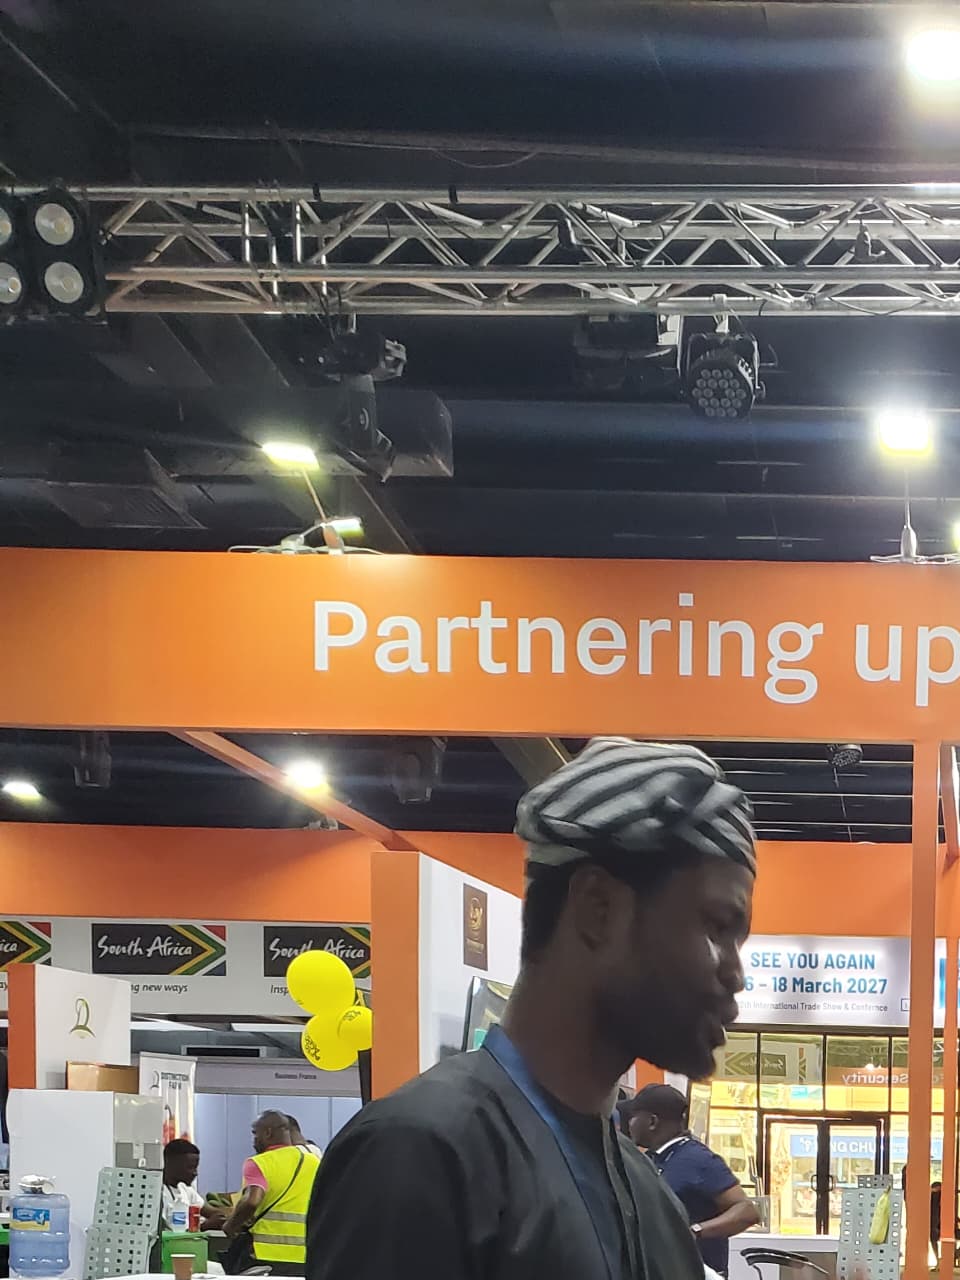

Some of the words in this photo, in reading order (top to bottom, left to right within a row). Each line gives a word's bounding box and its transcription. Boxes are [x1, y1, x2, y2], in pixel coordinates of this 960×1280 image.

[314, 592, 823, 704] Partnering
[97, 935, 144, 958] South
[146, 936, 193, 957] Africa
[751, 952, 782, 968] SEE
[786, 953, 819, 970] YOU
[823, 953, 876, 970] AGAIN
[142, 984, 162, 992] new
[164, 984, 188, 993] ways
[743, 975, 755, 992] 6
[773, 976, 788, 993] 18
[792, 977, 843, 993] March
[847, 978, 888, 995] 2027
[801, 1003, 821, 1012] Trade
